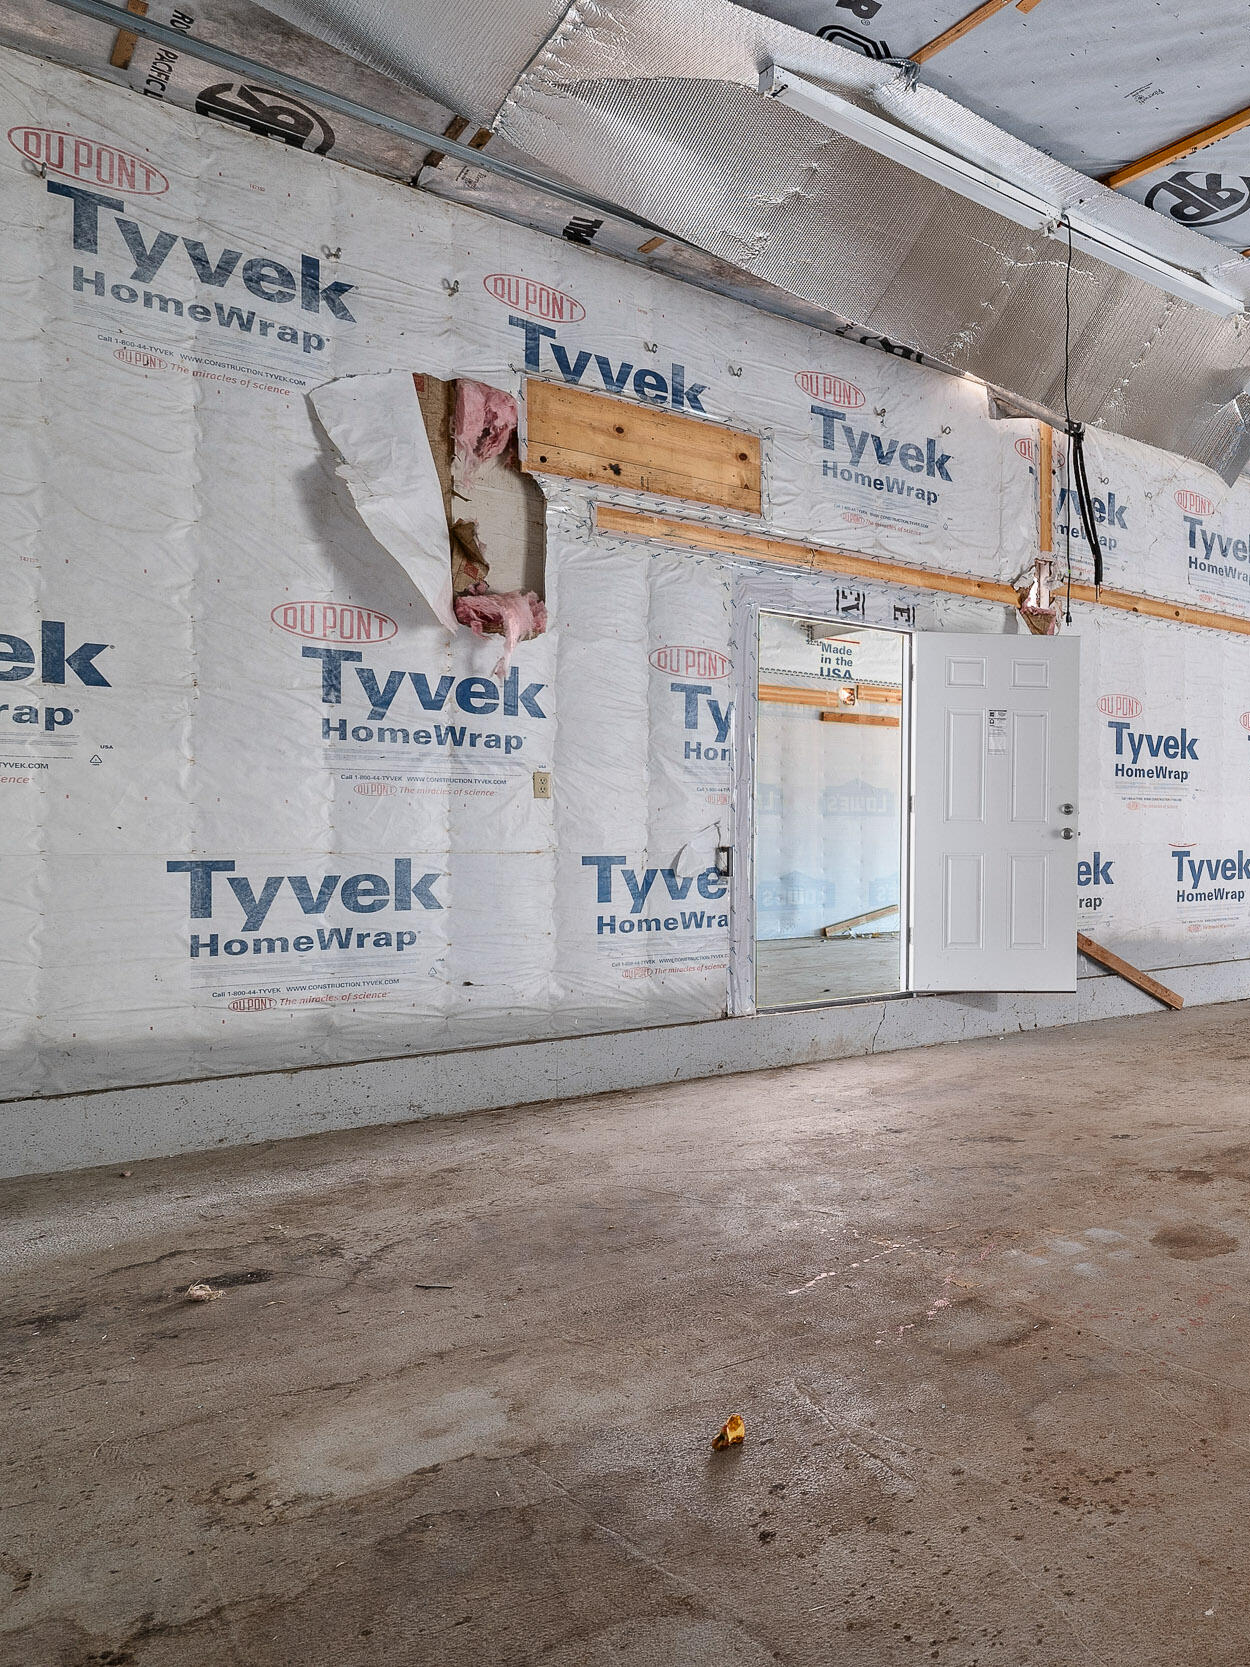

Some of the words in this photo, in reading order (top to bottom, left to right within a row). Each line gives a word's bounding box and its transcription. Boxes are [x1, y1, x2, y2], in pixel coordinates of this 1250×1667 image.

[170, 362, 189, 375] The
[192, 370, 237, 385] miracles
[239, 378, 250, 388] of
[253, 382, 290, 396] science
[811, 405, 953, 482] Tyvek
[822, 460, 938, 505] HomeWrap
[821, 643, 852, 655] Made
[821, 654, 831, 664] in
[836, 656, 853, 666] the
[1108, 721, 1199, 764] Tyvek
[1115, 764, 1189, 782] HomeWrap
[400, 786, 414, 794] The
[167, 858, 443, 932] Tyvek
[582, 856, 728, 914] Tyve
[1177, 888, 1245, 902] HomeWrap
[597, 911, 728, 934] HomeWra
[190, 928, 417, 957] HomeWrap
[280, 998, 296, 1006] The
[353, 991, 386, 1000] science
